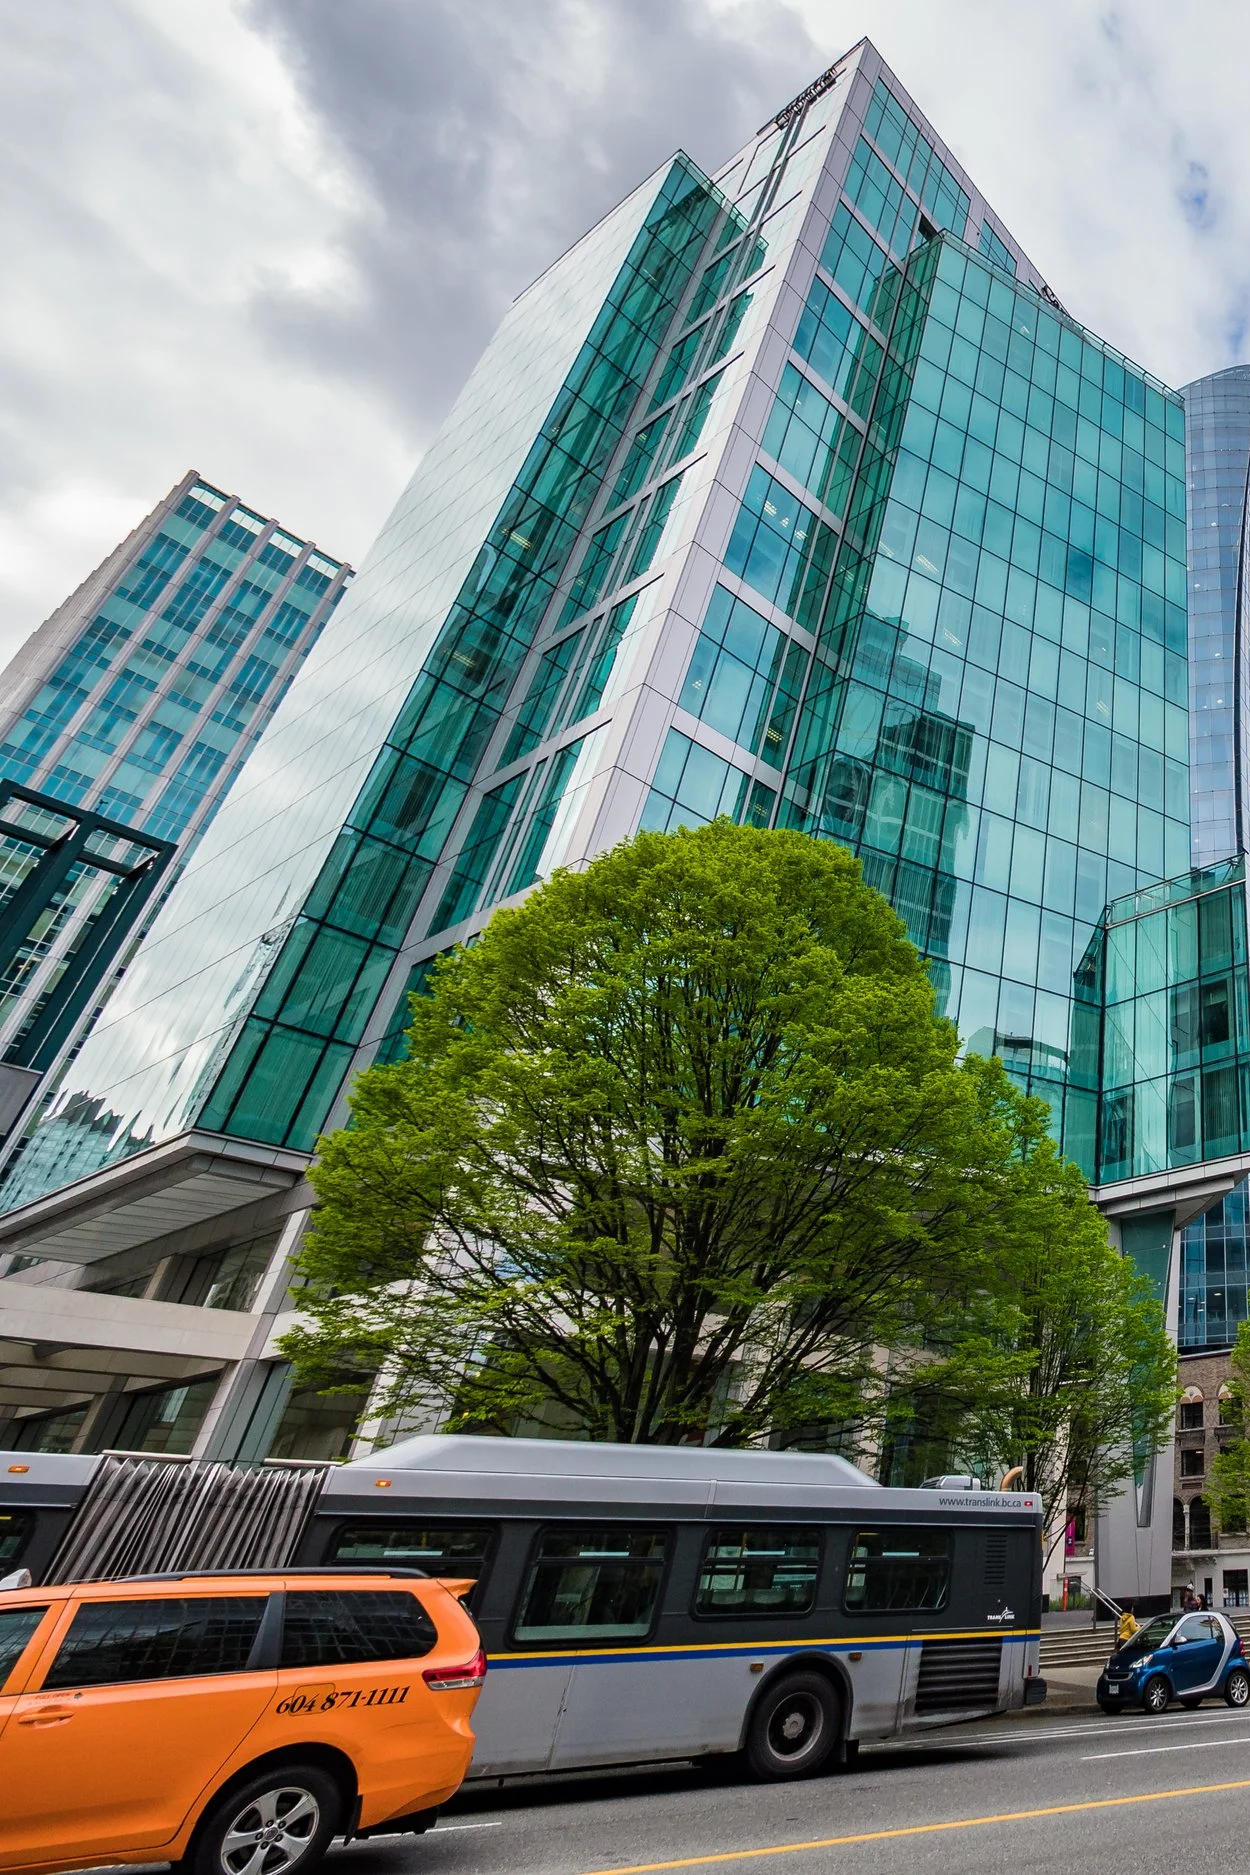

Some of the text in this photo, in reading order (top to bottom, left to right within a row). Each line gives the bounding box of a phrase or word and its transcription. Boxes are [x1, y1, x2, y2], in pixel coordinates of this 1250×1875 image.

[939, 1497, 1021, 1507] www.translink.bc.ca
[275, 1685, 411, 1714] 604 871-1111
